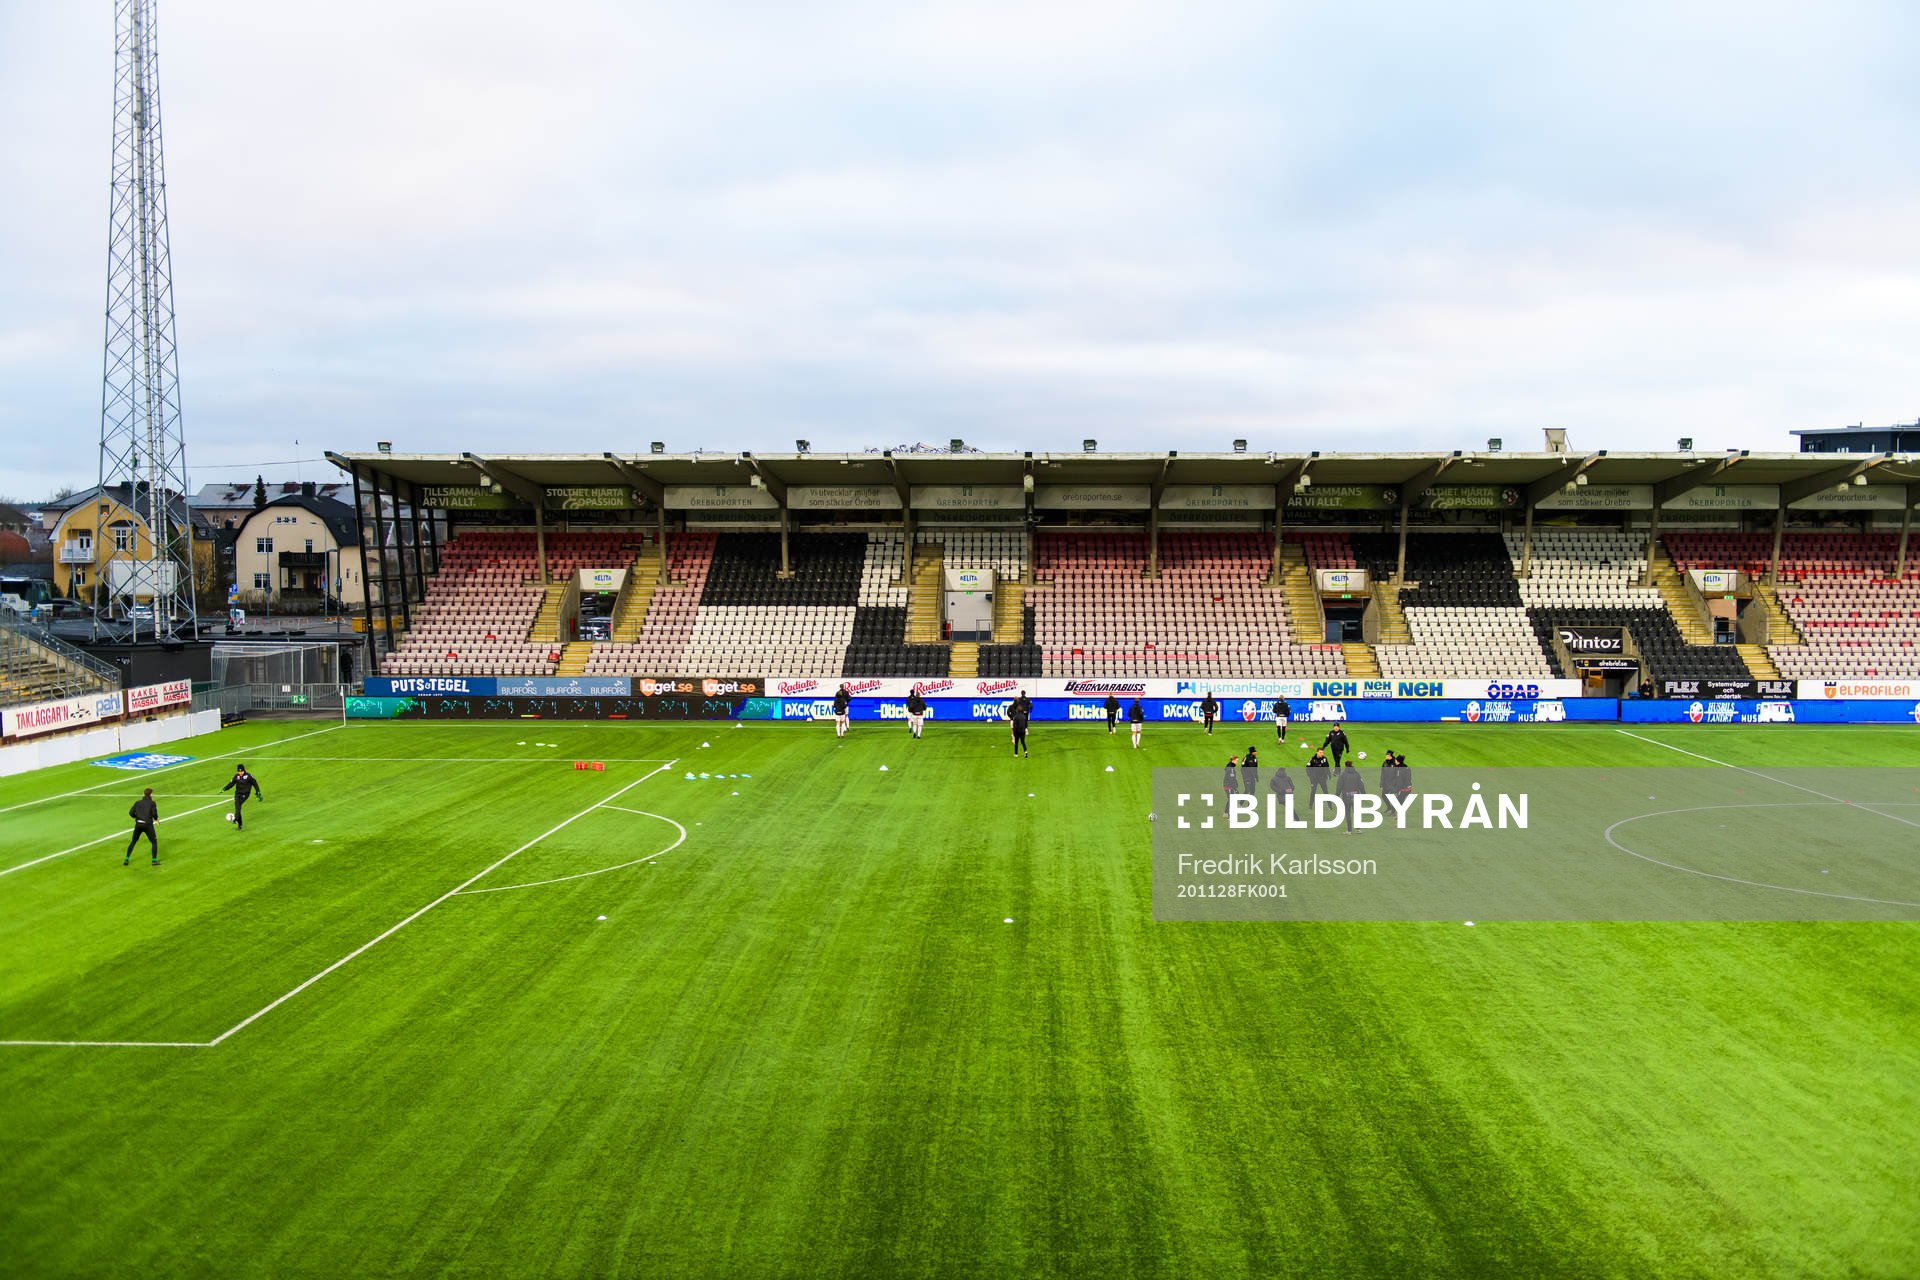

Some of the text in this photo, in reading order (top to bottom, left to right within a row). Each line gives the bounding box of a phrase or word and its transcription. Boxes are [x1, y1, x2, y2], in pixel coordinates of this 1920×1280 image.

[1560, 631, 1620, 649] Printoz
[131, 687, 158, 698] KAKEL
[163, 682, 188, 692] KAKEL
[501, 686, 538, 696] BJURFORS
[545, 686, 583, 696] BJURFORS
[590, 686, 627, 696] BJURFORS
[1200, 682, 1301, 695] HusmanHagberg
[1487, 680, 1540, 699] ÖBAB
[1665, 682, 1699, 693] FLEX
[1757, 682, 1792, 693] FLEX
